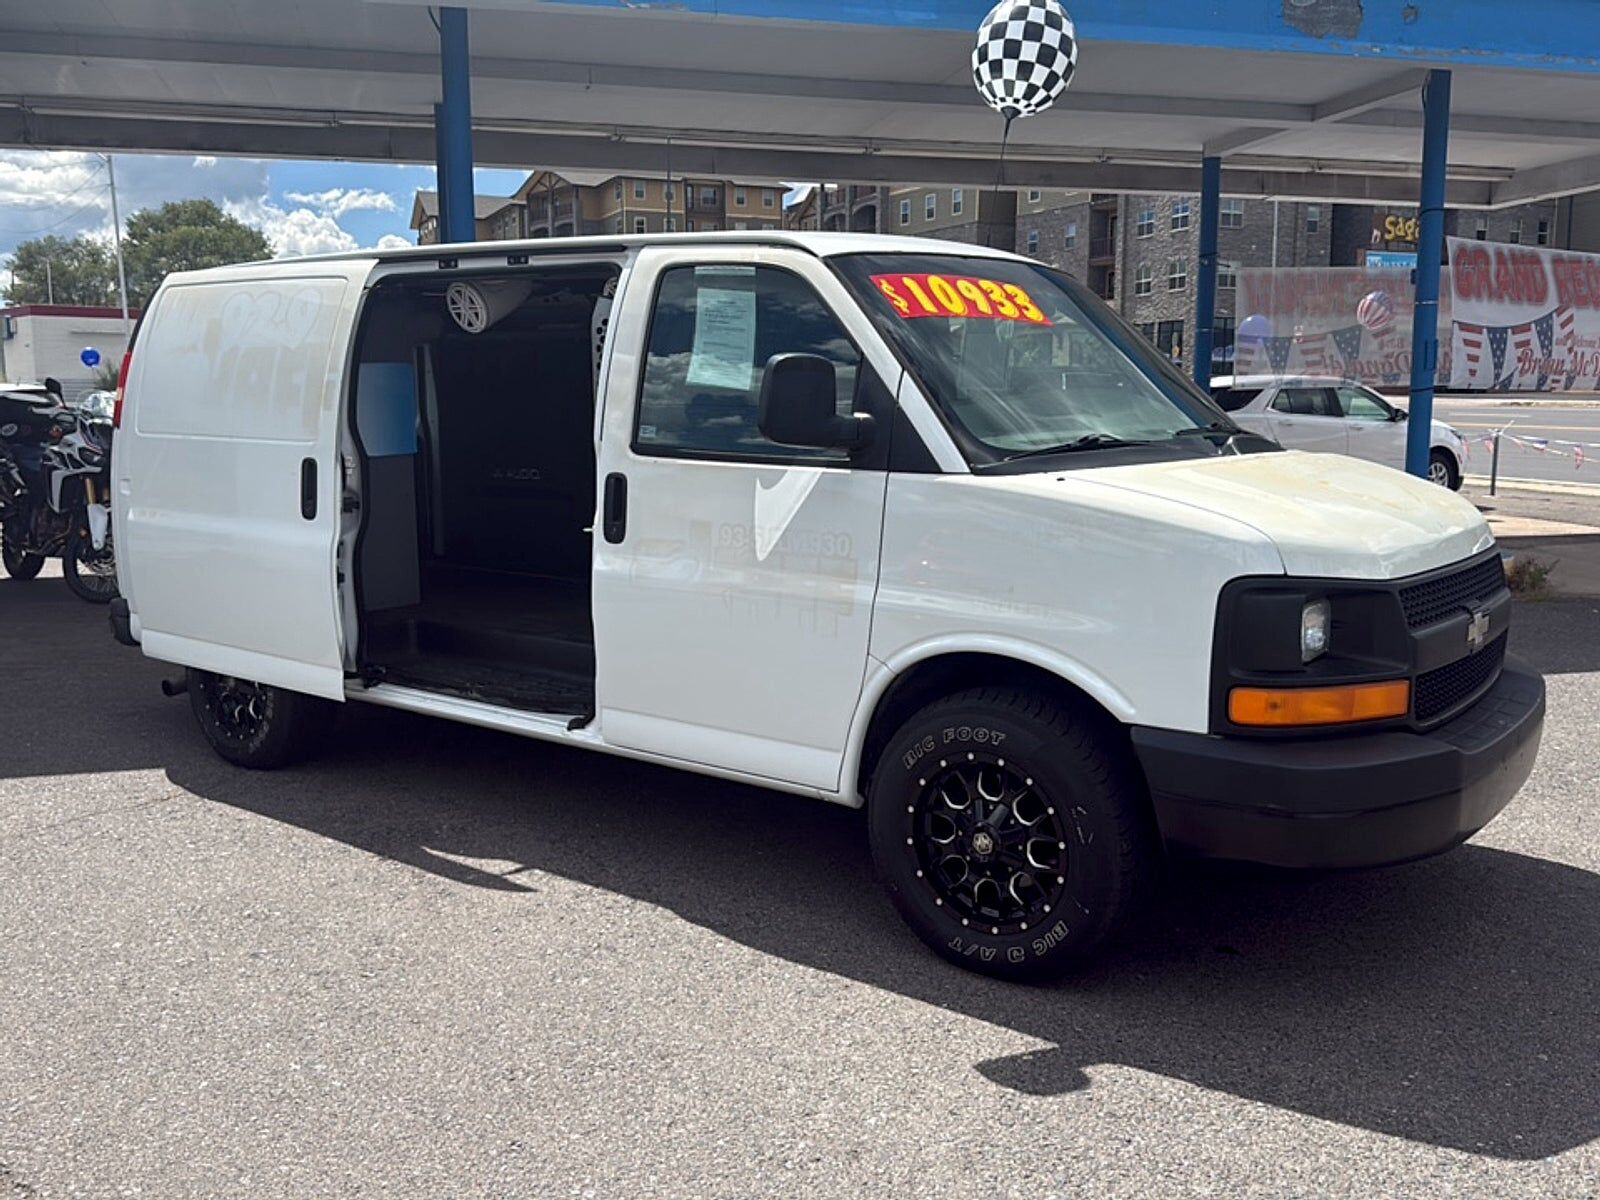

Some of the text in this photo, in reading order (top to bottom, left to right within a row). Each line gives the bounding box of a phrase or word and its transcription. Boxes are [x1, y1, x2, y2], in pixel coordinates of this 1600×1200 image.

[1384, 214, 1420, 241] Sag
[1454, 245, 1549, 306] GRAND
[903, 726, 1006, 770] BIG FOOT
